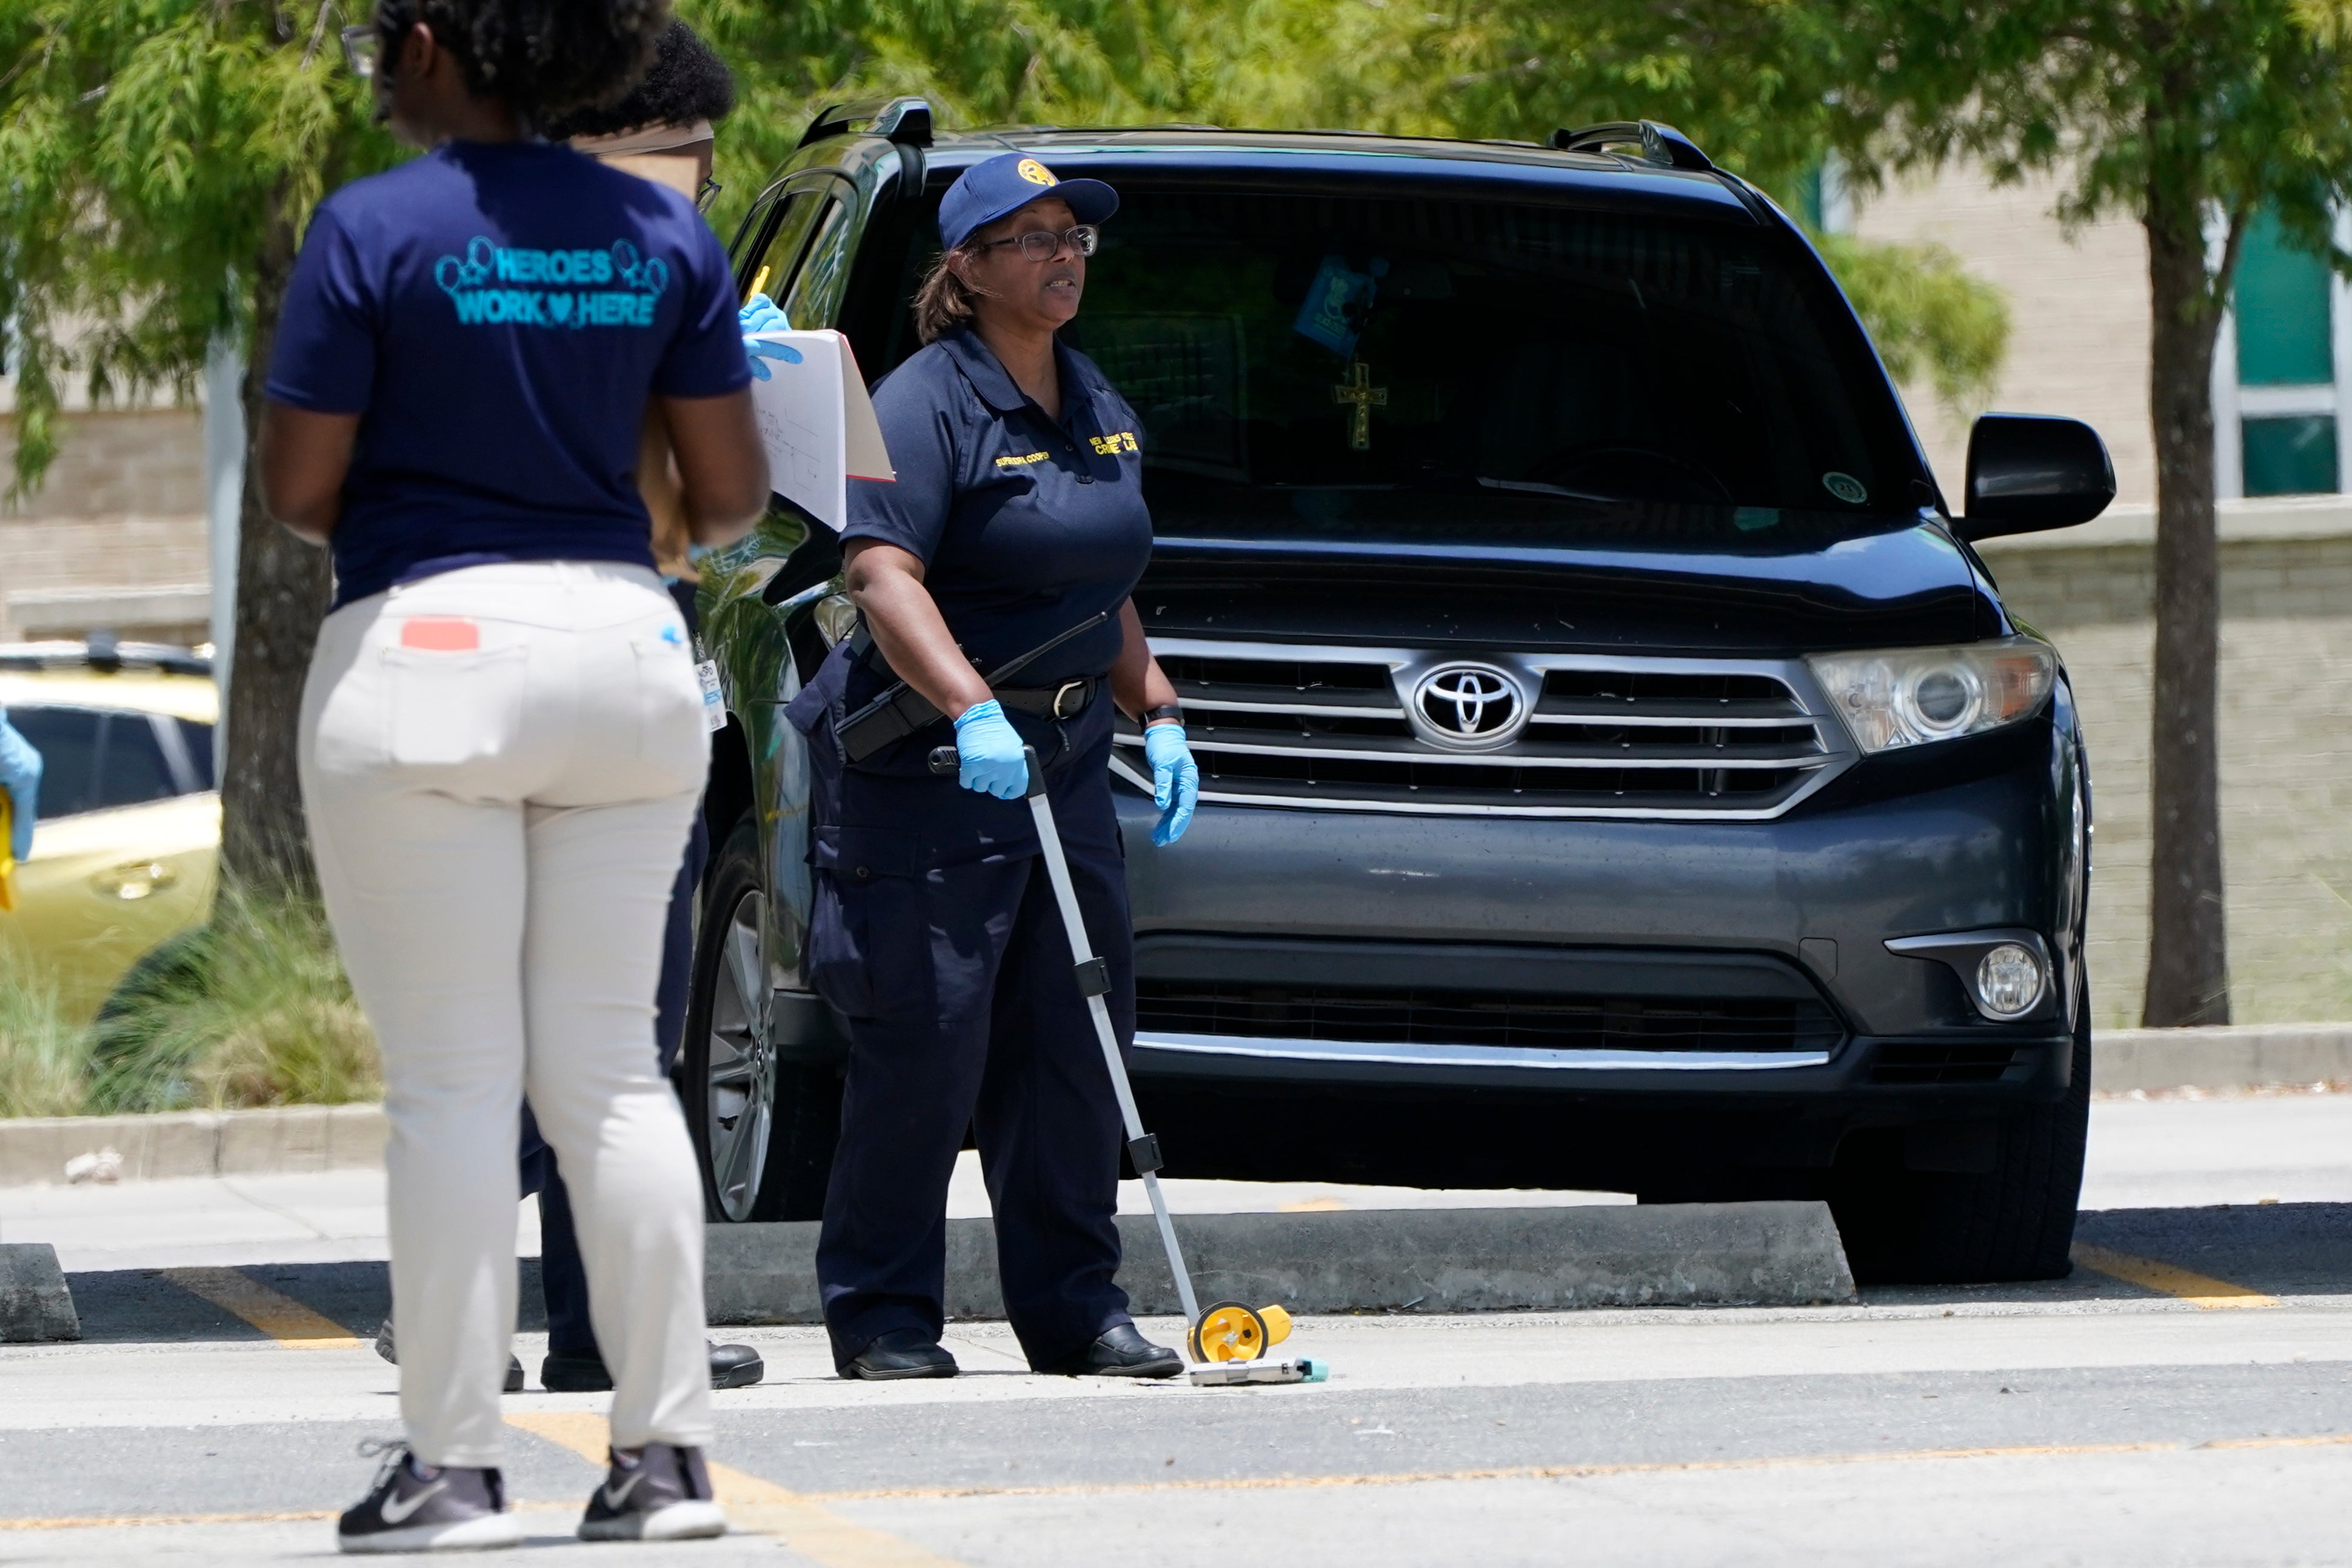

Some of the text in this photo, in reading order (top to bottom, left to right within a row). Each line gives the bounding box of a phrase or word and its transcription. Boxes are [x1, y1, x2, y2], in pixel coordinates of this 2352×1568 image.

[496, 248, 613, 282] HEROES
[455, 290, 655, 327] WORK HERE
